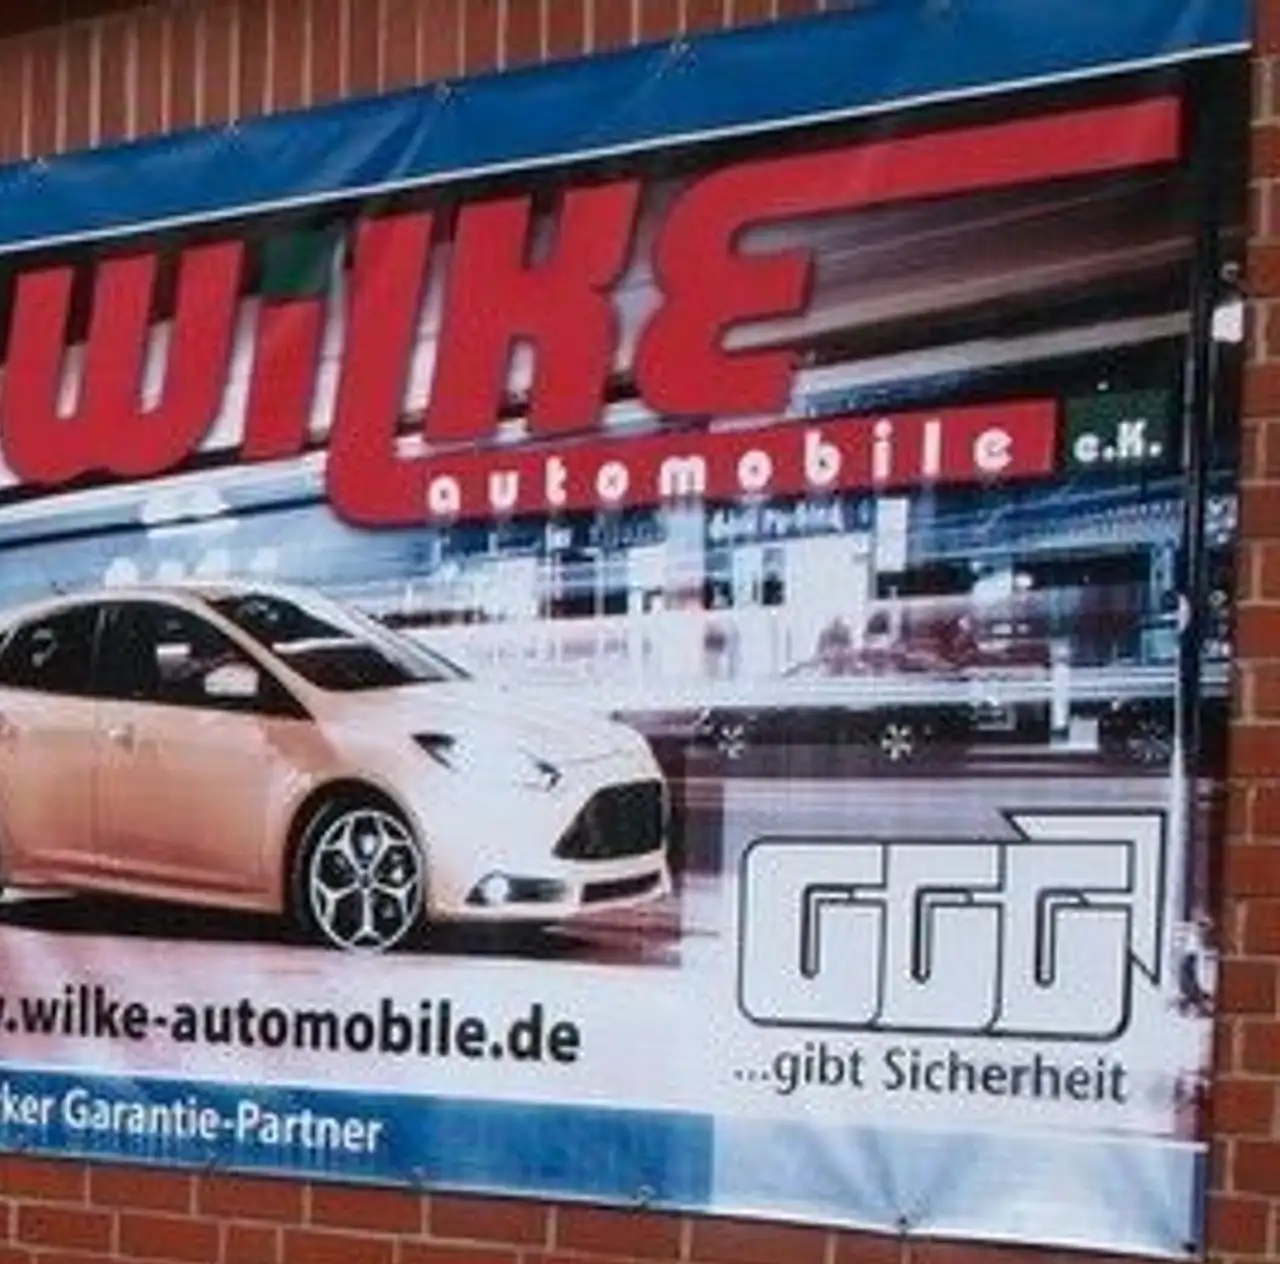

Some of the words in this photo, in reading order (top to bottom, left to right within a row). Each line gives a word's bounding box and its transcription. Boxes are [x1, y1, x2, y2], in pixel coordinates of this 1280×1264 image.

[426, 416, 1015, 517] automobile
[883, 1046, 1128, 1104] Sicherheit
[61, 1087, 385, 1153] Garantie-Partner
